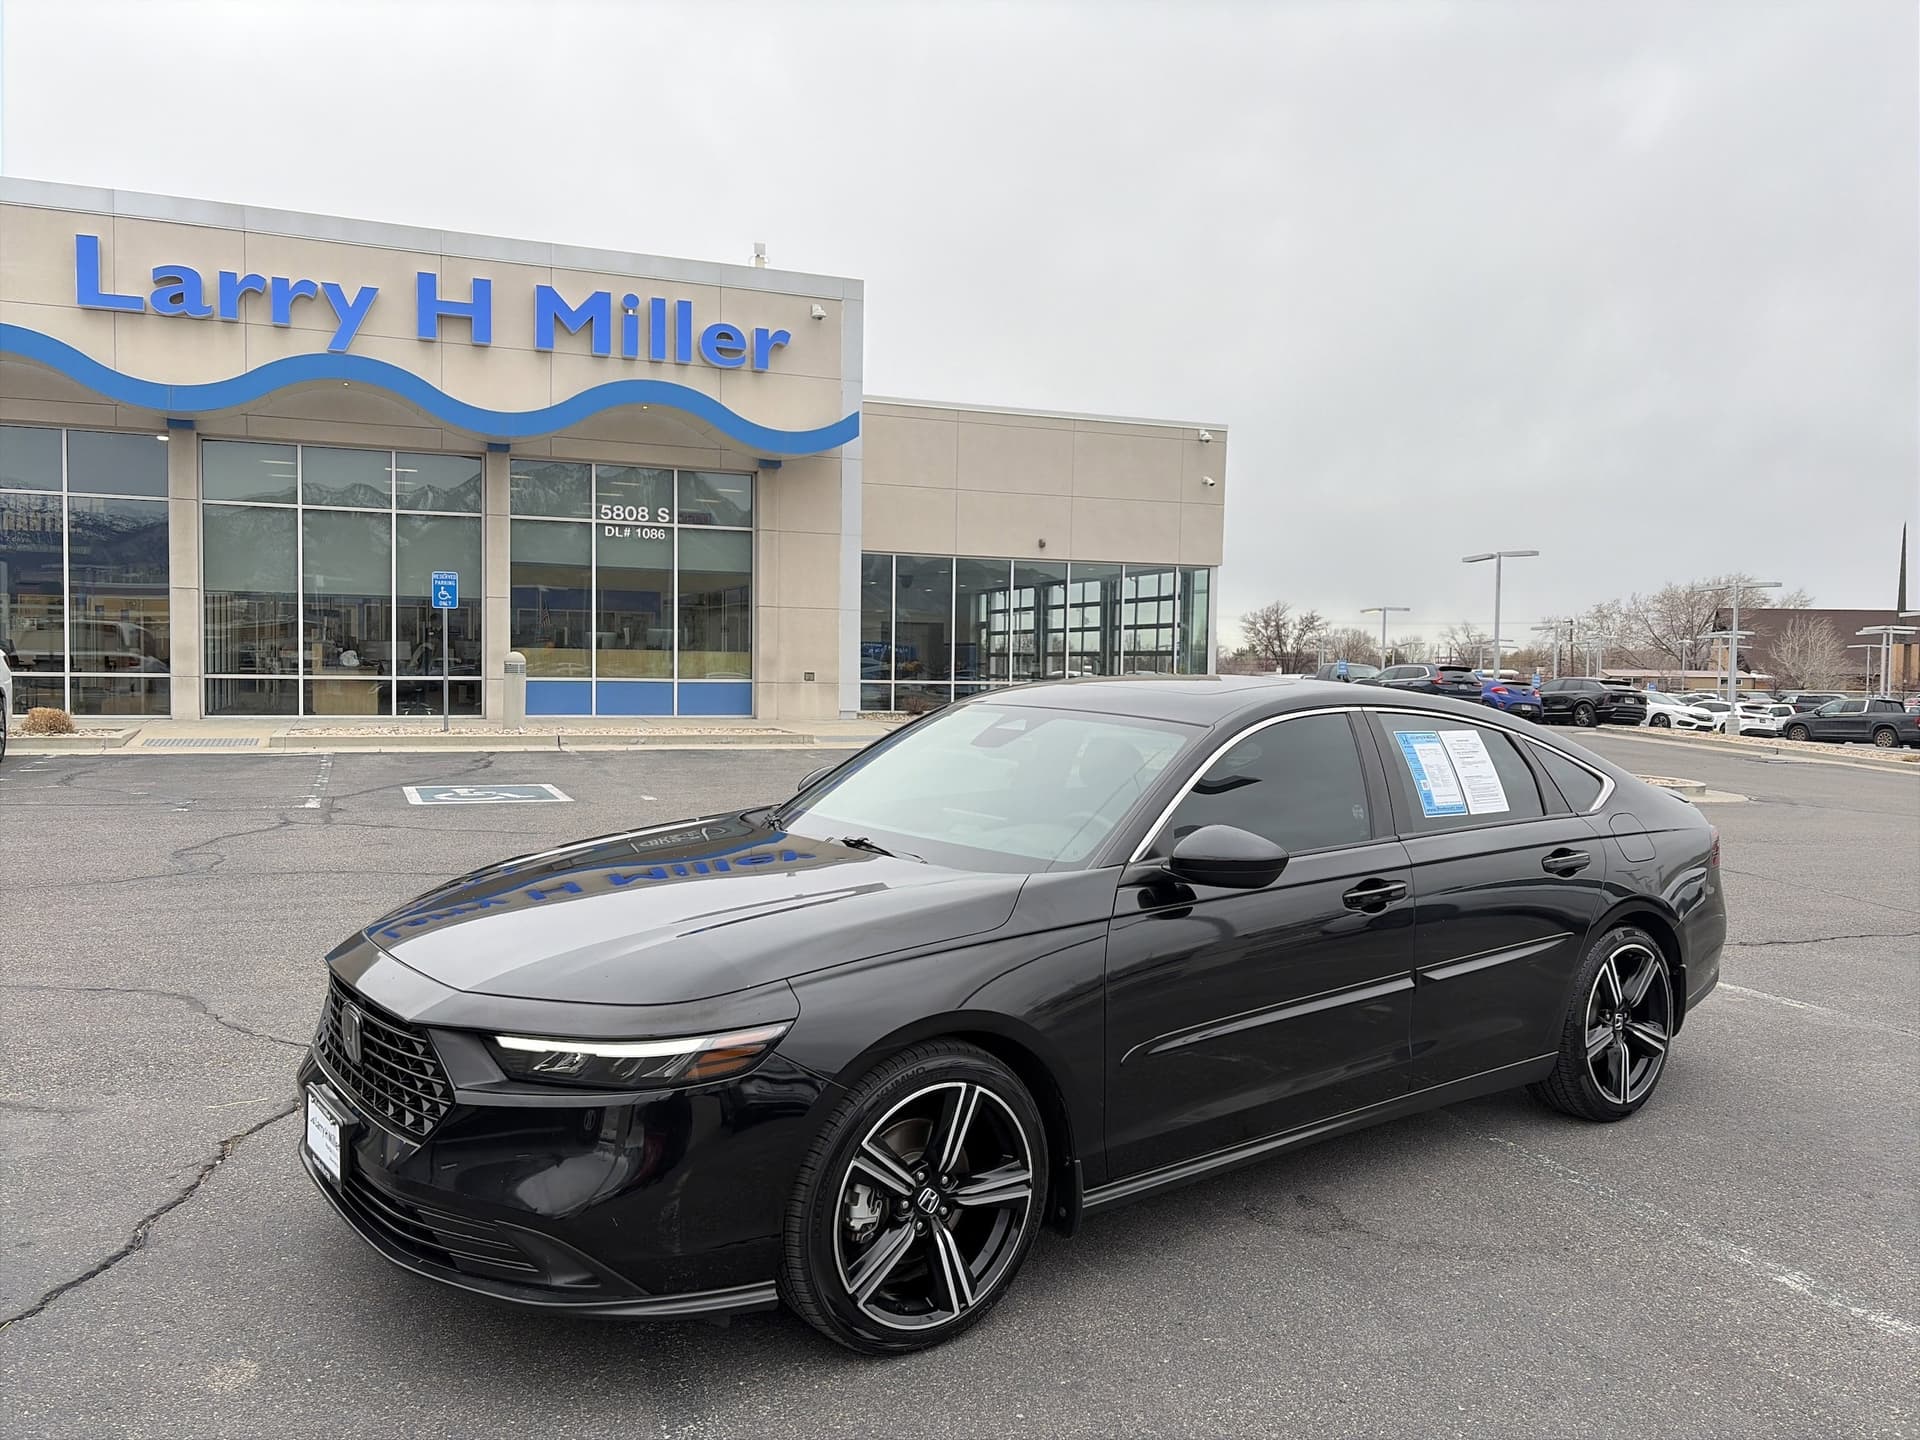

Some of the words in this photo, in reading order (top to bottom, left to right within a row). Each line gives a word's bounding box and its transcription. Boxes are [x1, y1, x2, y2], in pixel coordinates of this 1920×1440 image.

[75, 233, 380, 354] Larry
[416, 271, 492, 346] H
[534, 284, 792, 373] Miller
[600, 504, 650, 521] 5808
[657, 507, 670, 522] S
[604, 525, 631, 537] DL#
[636, 528, 666, 540] 1086
